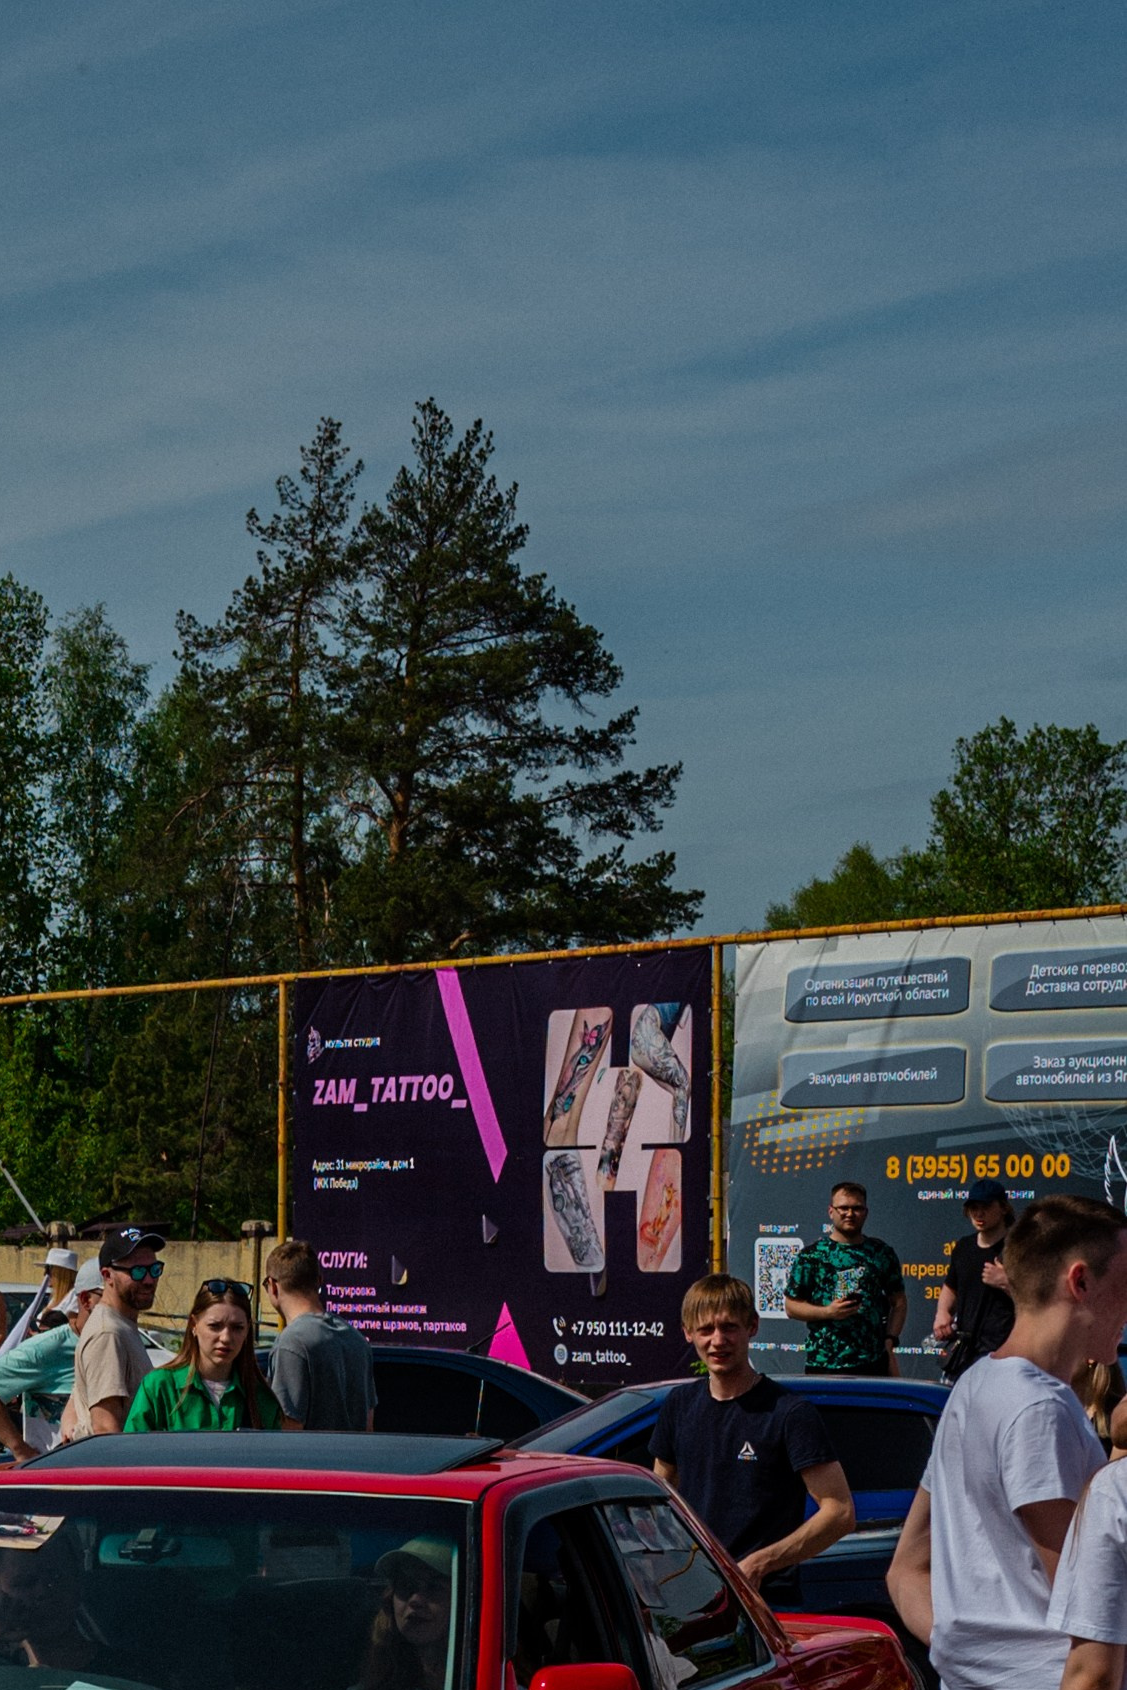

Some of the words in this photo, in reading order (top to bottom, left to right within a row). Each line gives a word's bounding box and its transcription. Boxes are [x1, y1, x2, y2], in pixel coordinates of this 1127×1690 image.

[1029, 963, 1079, 980] Детские
[804, 977, 874, 993] Организация
[876, 969, 948, 988] путешествий
[1025, 980, 1080, 997] Доставка
[805, 996, 819, 1007] по
[820, 992, 844, 1006] всей
[846, 991, 902, 1007] Иркутской
[905, 987, 950, 1001] области
[324, 1038, 352, 1049] МУЛЬТИ
[353, 1037, 381, 1049] СТУДИЯ
[1033, 1055, 1066, 1069] Заказ
[808, 1072, 861, 1087] Эвакуация
[862, 1066, 938, 1083] автомобилей
[1015, 1070, 1094, 1086] автомобилей
[1097, 1071, 1112, 1084] из
[312, 1158, 335, 1174] Адрес:
[335, 1158, 345, 1170] 31
[392, 1160, 409, 1172] дом
[409, 1157, 415, 1169] 1
[885, 1155, 901, 1179] 8
[906, 1153, 969, 1184] (3955)
[974, 1153, 1001, 1179] 65
[1005, 1153, 1036, 1178] 00
[1041, 1152, 1072, 1179] 00
[313, 1176, 329, 1191] (ЖК
[329, 1176, 359, 1190] Победа)
[917, 1188, 954, 1201] единый
[1005, 1189, 1035, 1200] пании
[317, 1251, 369, 1270] СЛУГИ:
[326, 1284, 376, 1298] Татуировка
[326, 1301, 390, 1314] Перманентный
[391, 1304, 427, 1314] макияж
[383, 1320, 422, 1333] шрамов,
[423, 1321, 467, 1334] партаков
[571, 1321, 585, 1336] +7
[586, 1321, 607, 1336] 950
[608, 1321, 665, 1337] 111-12-42
[571, 1349, 632, 1367] zam_tattoo_
